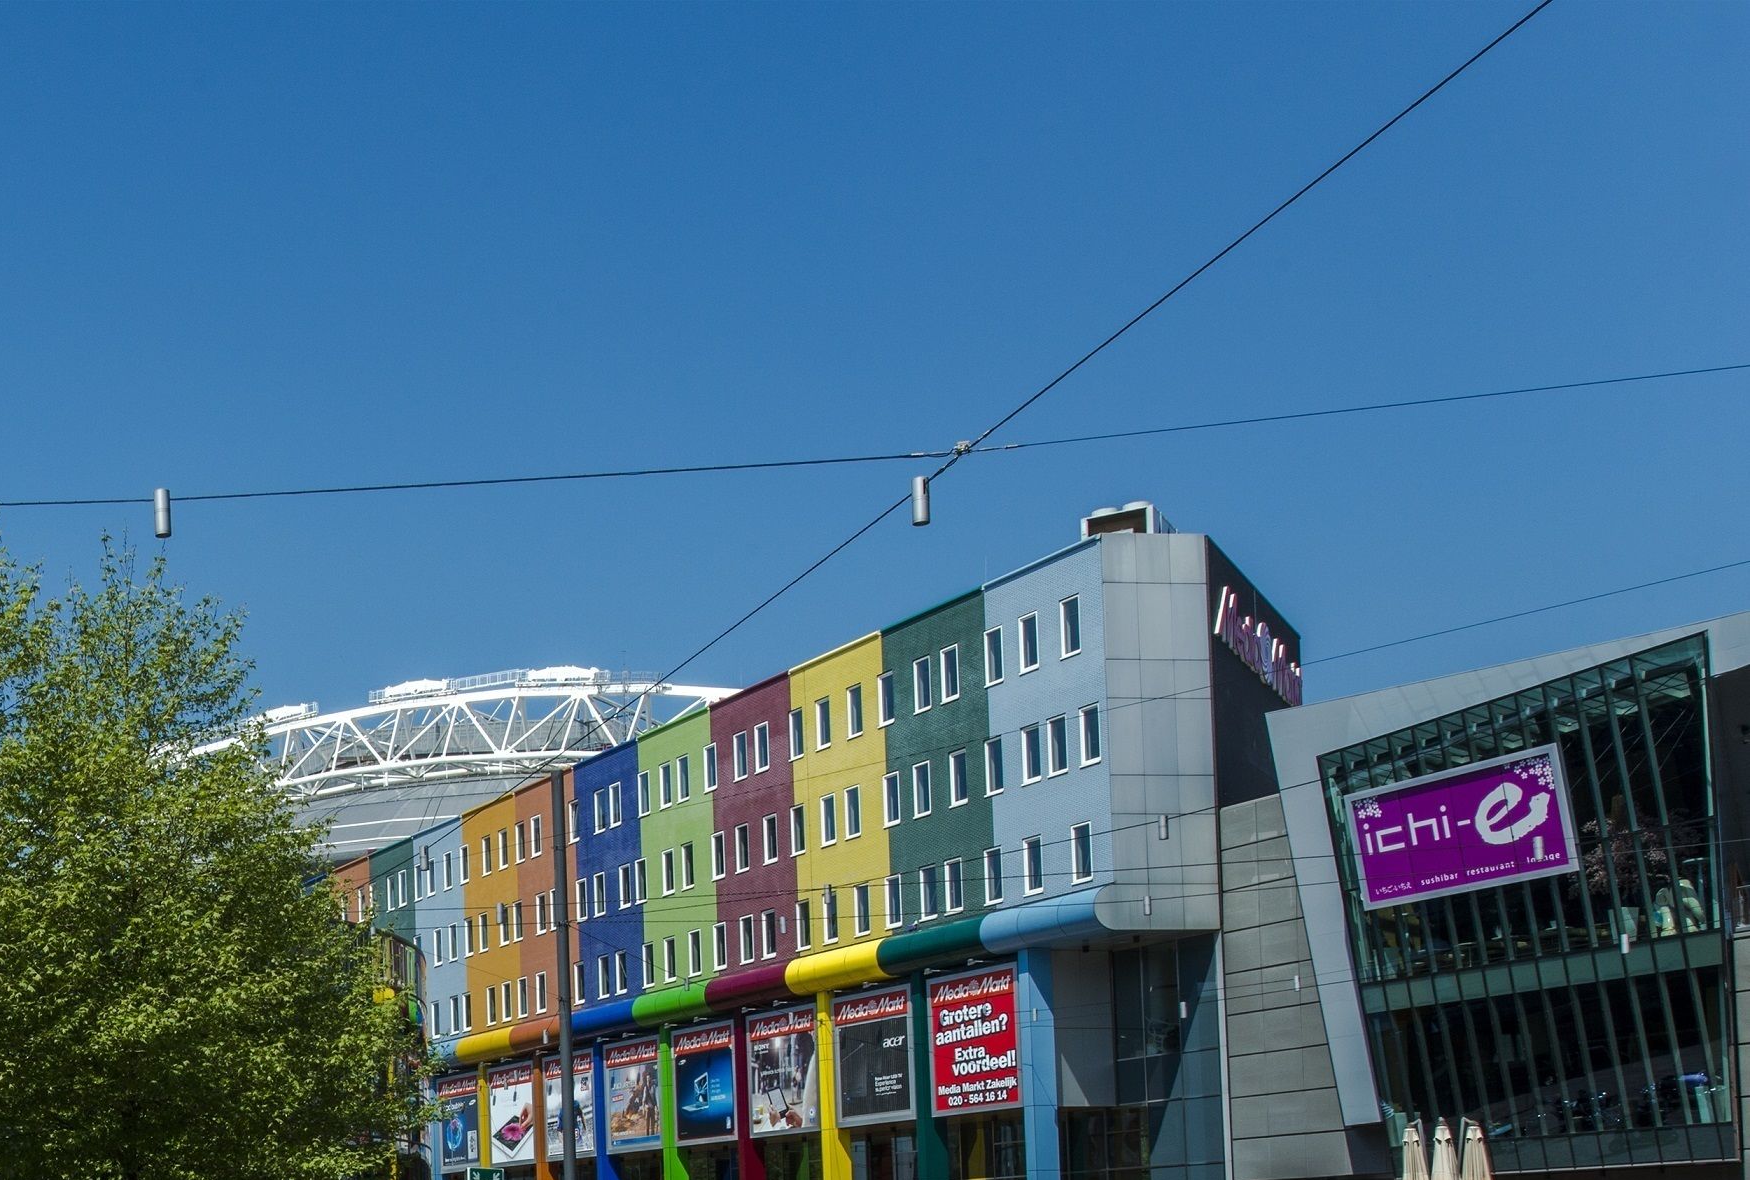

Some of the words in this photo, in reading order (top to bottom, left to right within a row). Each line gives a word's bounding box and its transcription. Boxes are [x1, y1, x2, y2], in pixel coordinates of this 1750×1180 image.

[1362, 782, 1550, 856] ichi-e
[1420, 872, 1458, 886] sushibar
[1466, 860, 1515, 876] restaurant
[1526, 852, 1561, 864] longe
[933, 985, 969, 1003] Media
[977, 975, 1010, 995] Markt
[837, 1003, 868, 1021] Media
[875, 996, 905, 1014] Markt
[940, 1002, 992, 1027] Grotere
[751, 1021, 781, 1038] Media
[786, 1014, 812, 1031] Markt
[936, 1013, 1008, 1046] aantallen?
[675, 1036, 701, 1052] Media
[707, 1029, 730, 1045] Markt
[883, 1035, 905, 1048] acer
[608, 1050, 629, 1064] Media
[635, 1044, 656, 1059] Markt
[952, 1049, 1016, 1077] voordeel!
[954, 1045, 986, 1062] Extra
[938, 1085, 961, 1096] Media
[962, 1081, 985, 1094] Markt
[986, 1076, 1018, 1090] Zakelijk
[948, 1096, 962, 1106] 020
[969, 1093, 983, 1104] 564
[985, 1091, 996, 1102] 16
[997, 1090, 1007, 1101] 14
